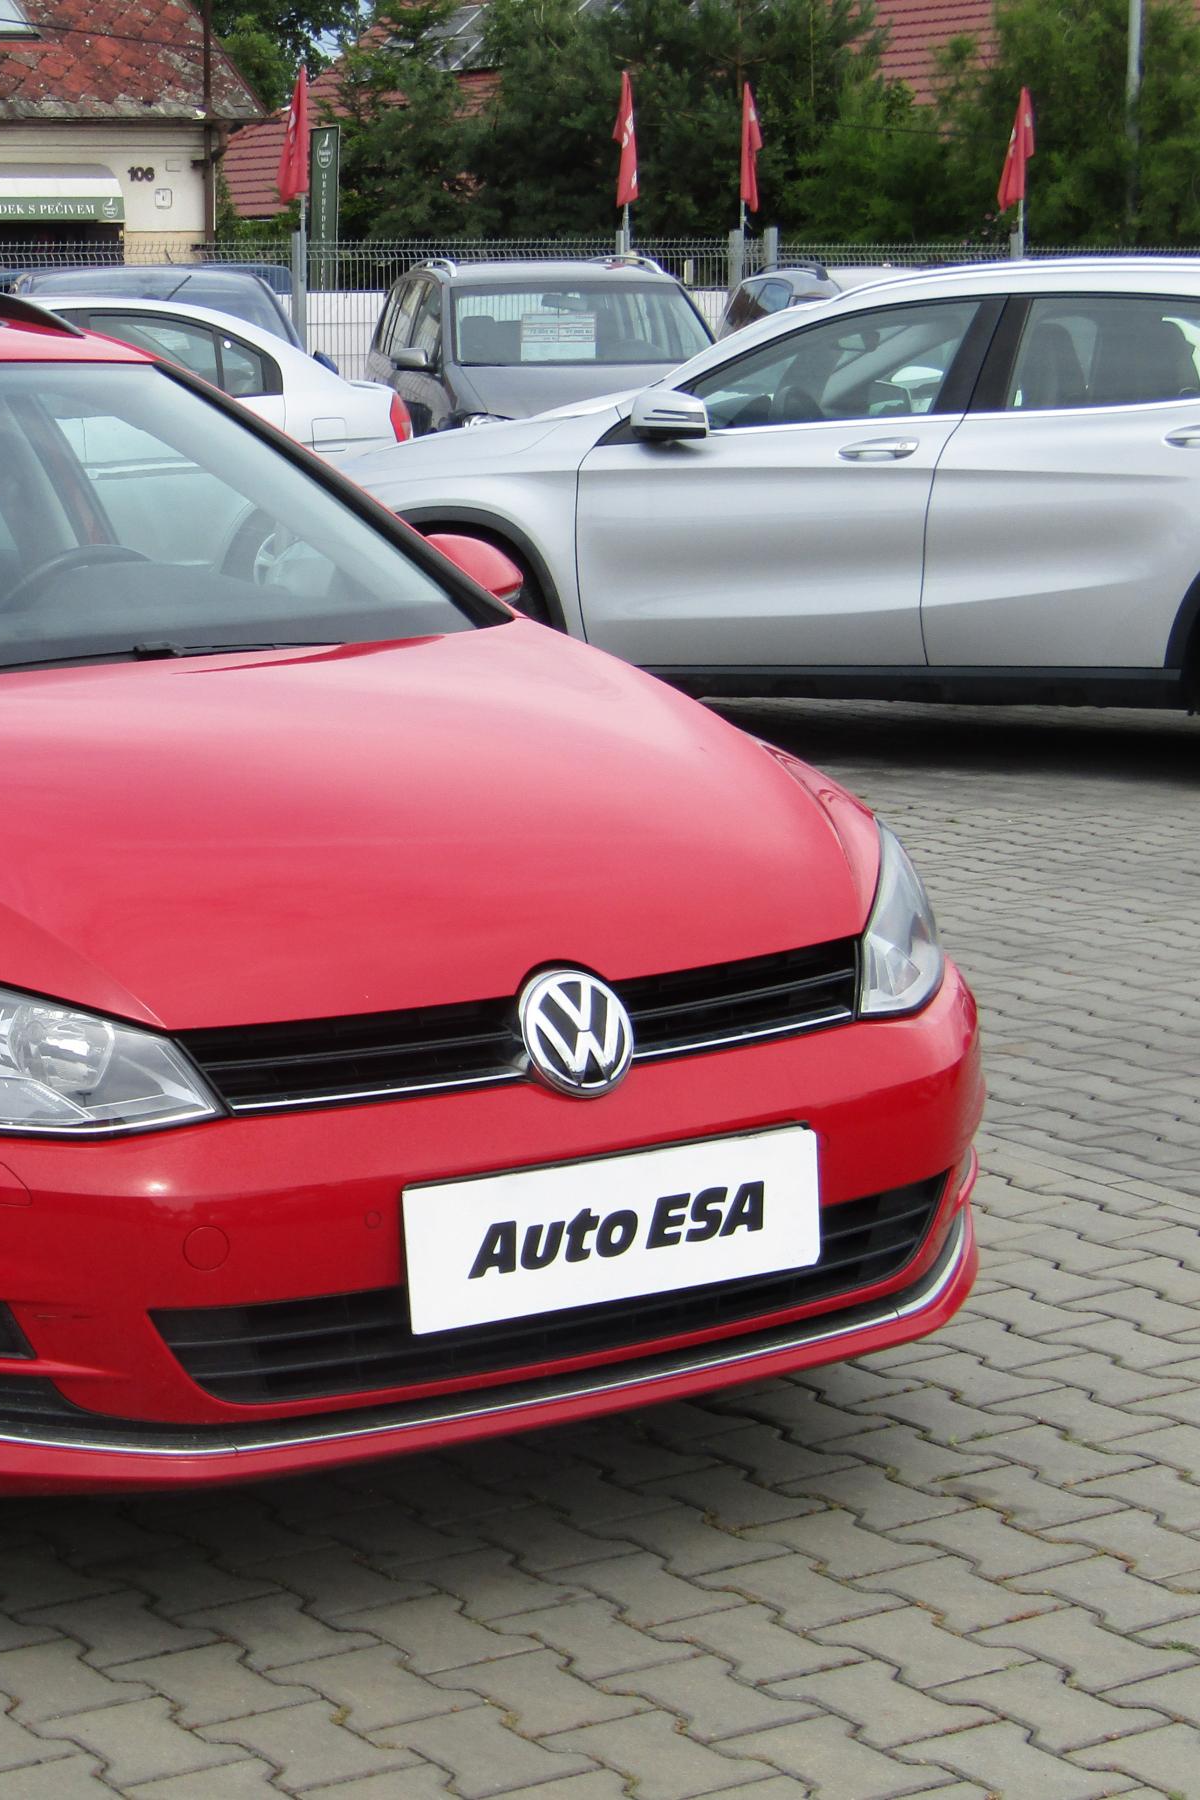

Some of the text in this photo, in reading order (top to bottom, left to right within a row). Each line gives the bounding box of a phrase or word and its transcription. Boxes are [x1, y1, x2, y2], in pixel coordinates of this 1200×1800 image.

[128, 166, 155, 182] 106
[28, 204, 36, 215] S
[39, 202, 96, 215] PEČIVEM
[467, 1180, 765, 1280] Auto ESA
